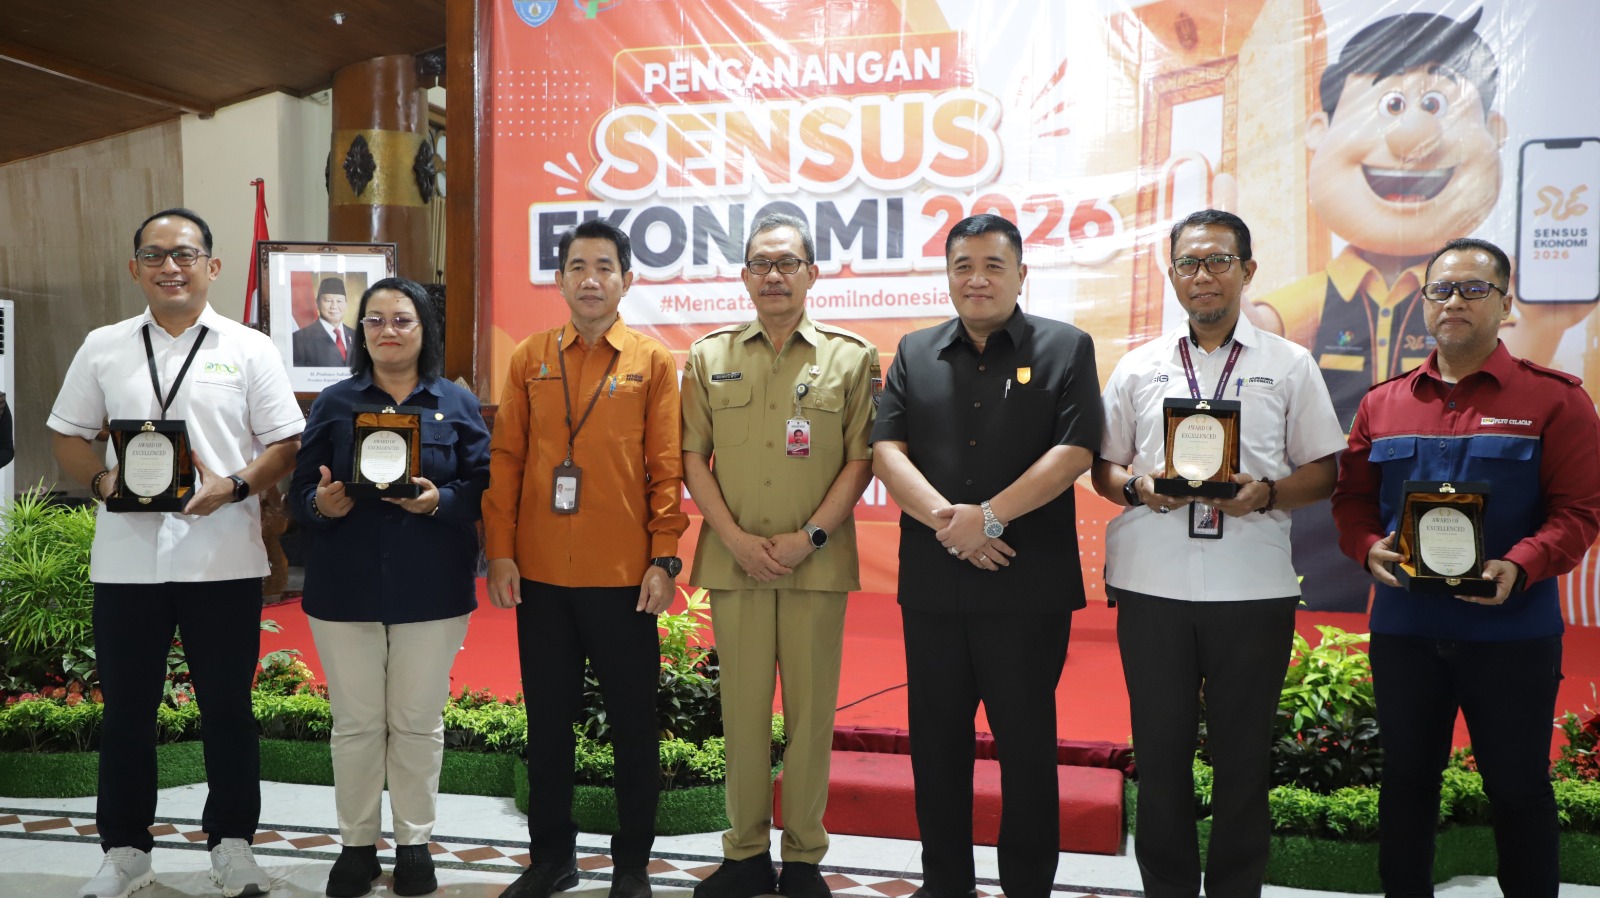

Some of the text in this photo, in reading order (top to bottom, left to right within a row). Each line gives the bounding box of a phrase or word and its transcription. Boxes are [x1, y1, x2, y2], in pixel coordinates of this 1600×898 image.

[644, 47, 941, 93] PENCANANGAN
[603, 97, 989, 191] SENSUS
[538, 196, 904, 271] EONMI
[1534, 228, 1588, 238] SENSUS
[1534, 239, 1588, 248] EKONOMI
[1534, 250, 1570, 260] 2026
